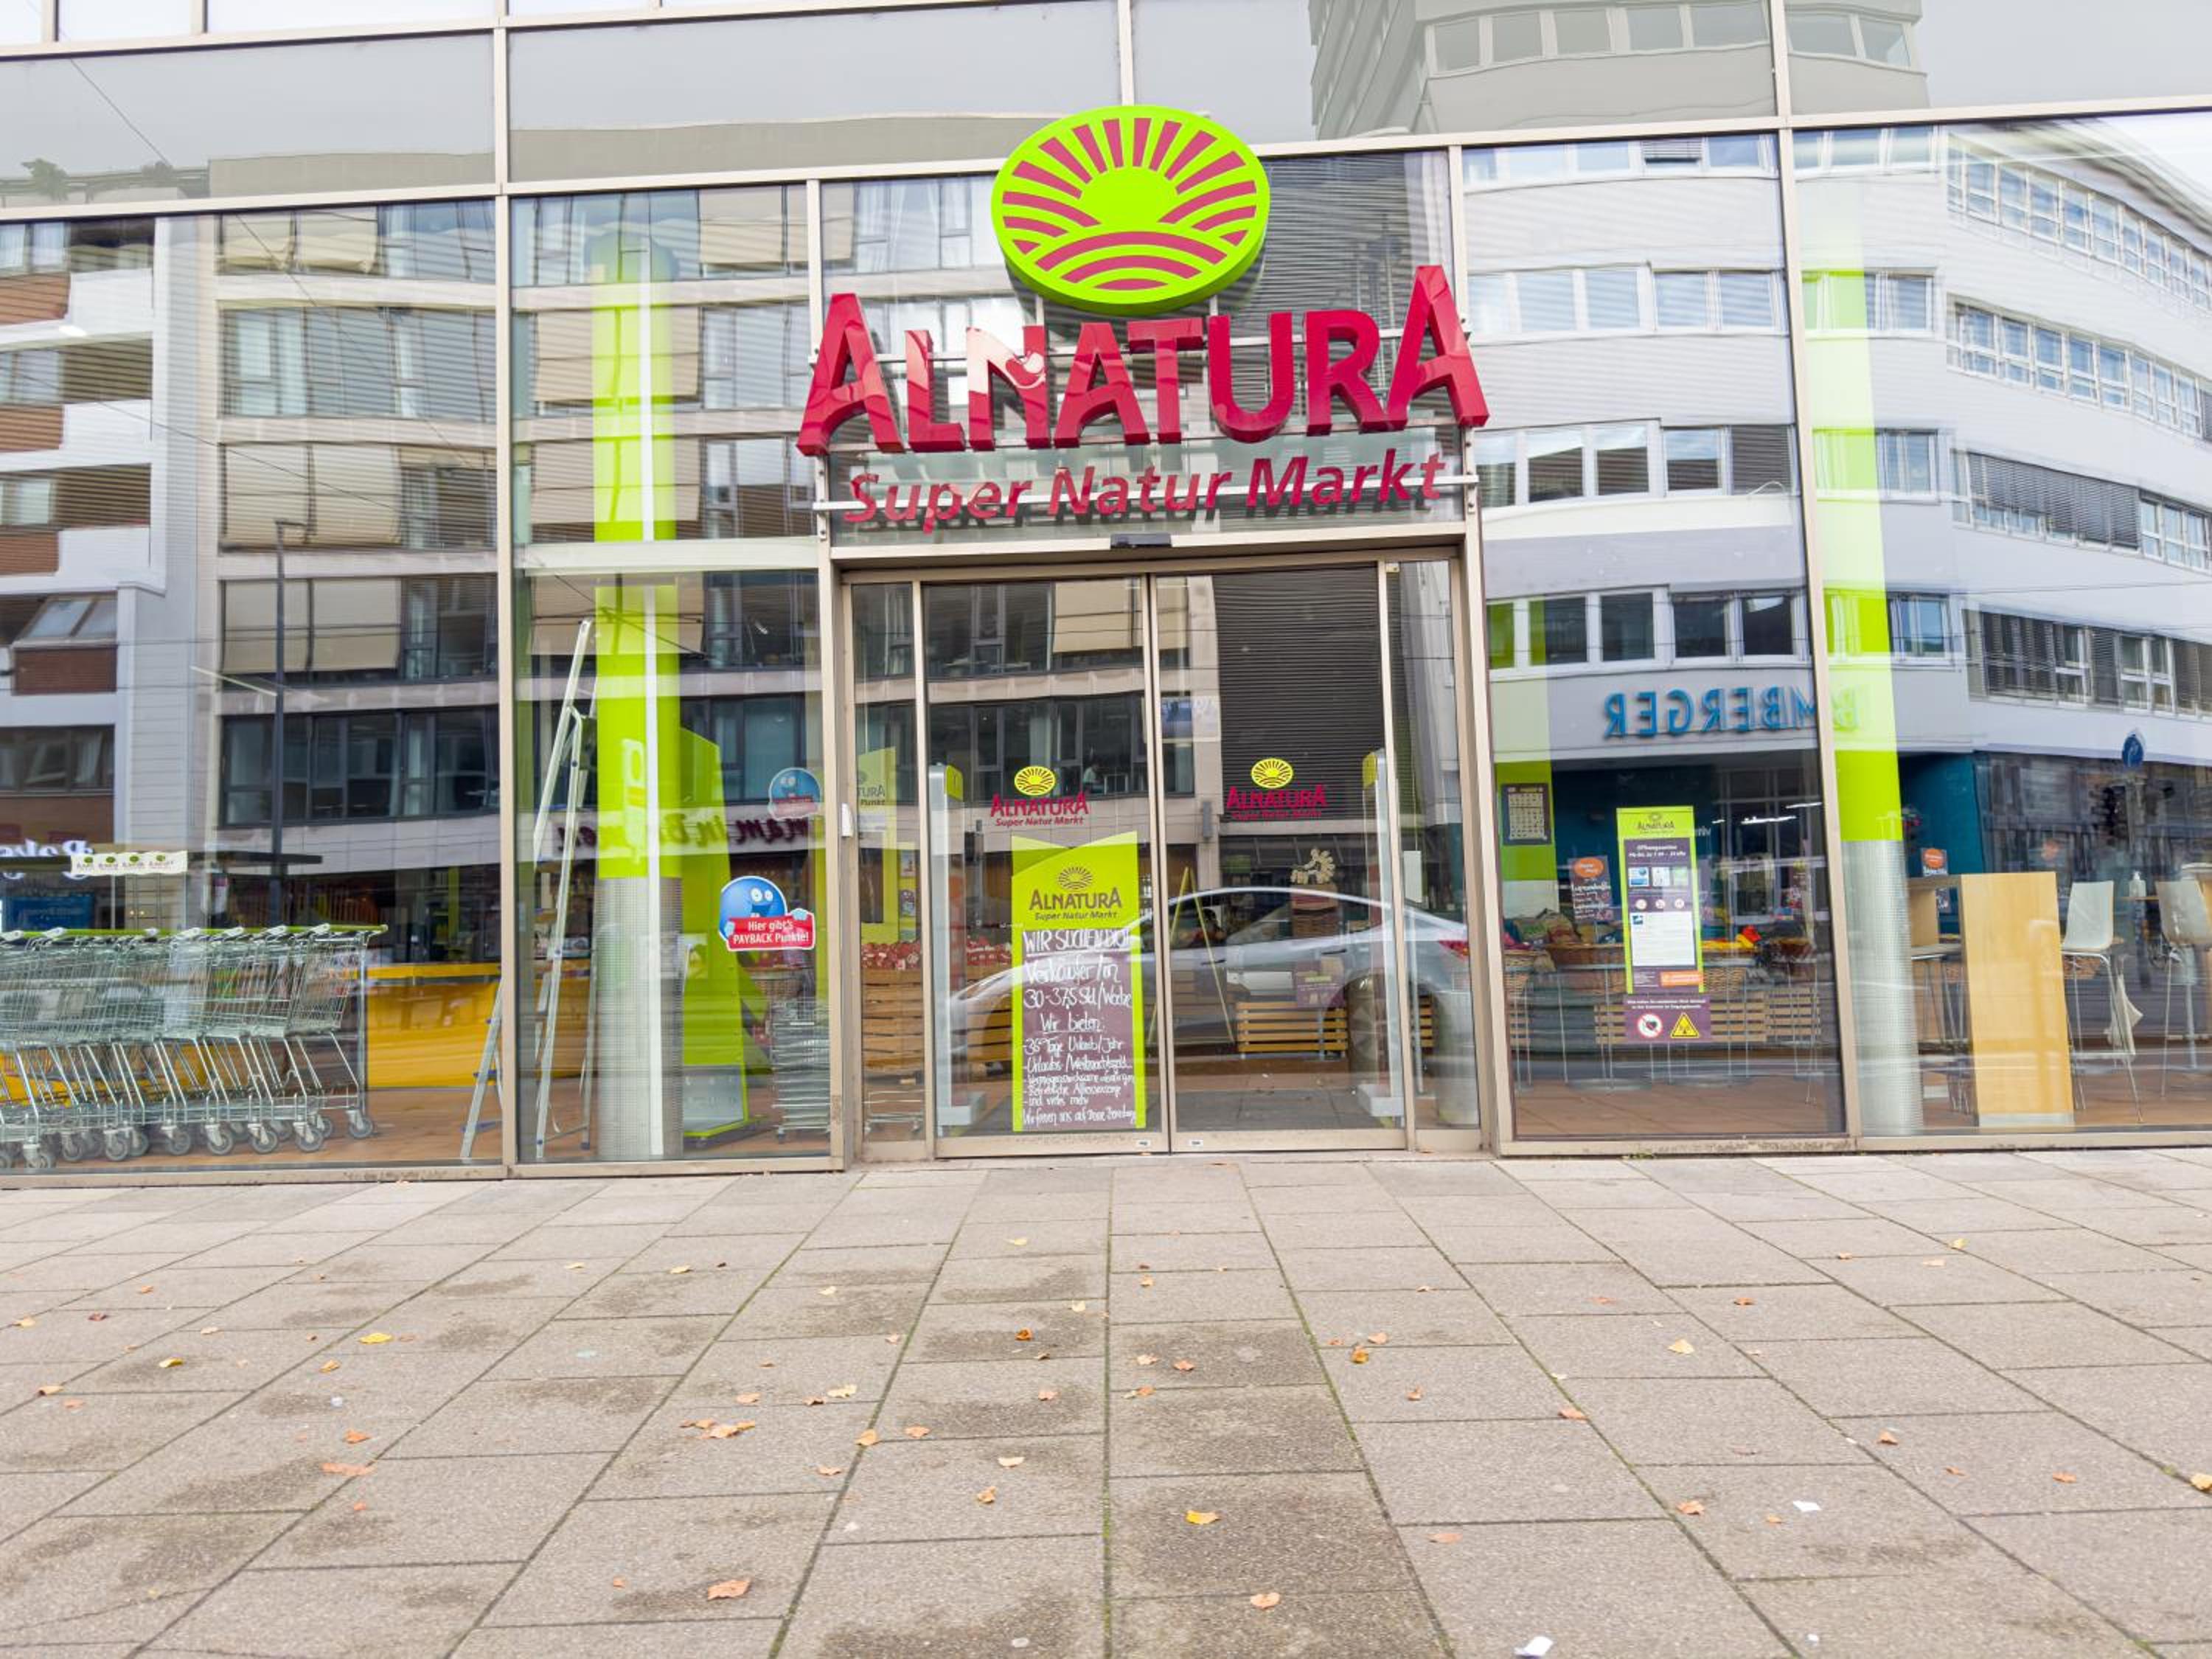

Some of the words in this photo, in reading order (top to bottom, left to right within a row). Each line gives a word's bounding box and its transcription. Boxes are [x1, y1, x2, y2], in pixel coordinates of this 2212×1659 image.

[796, 264, 1490, 456] ALNATURA
[842, 472, 1031, 534] Super
[1047, 465, 1233, 523] Natur
[1245, 448, 1447, 510] Markt
[990, 791, 1090, 818] ALNATURA
[1227, 785, 1328, 810] ALNATURA
[995, 818, 1024, 828] Super
[1026, 818, 1053, 826] Natur
[1054, 817, 1085, 826] Markt
[1029, 887, 1121, 911] ALNATURA
[748, 921, 768, 932] Hier
[769, 919, 794, 933] gibt's
[1034, 912, 1060, 921] Super
[1062, 911, 1088, 919] Natur
[1091, 910, 1117, 919] Markt
[733, 933, 773, 945] PAYBACK
[775, 932, 809, 943] Punkte!
[1023, 930, 1052, 953] WIR
